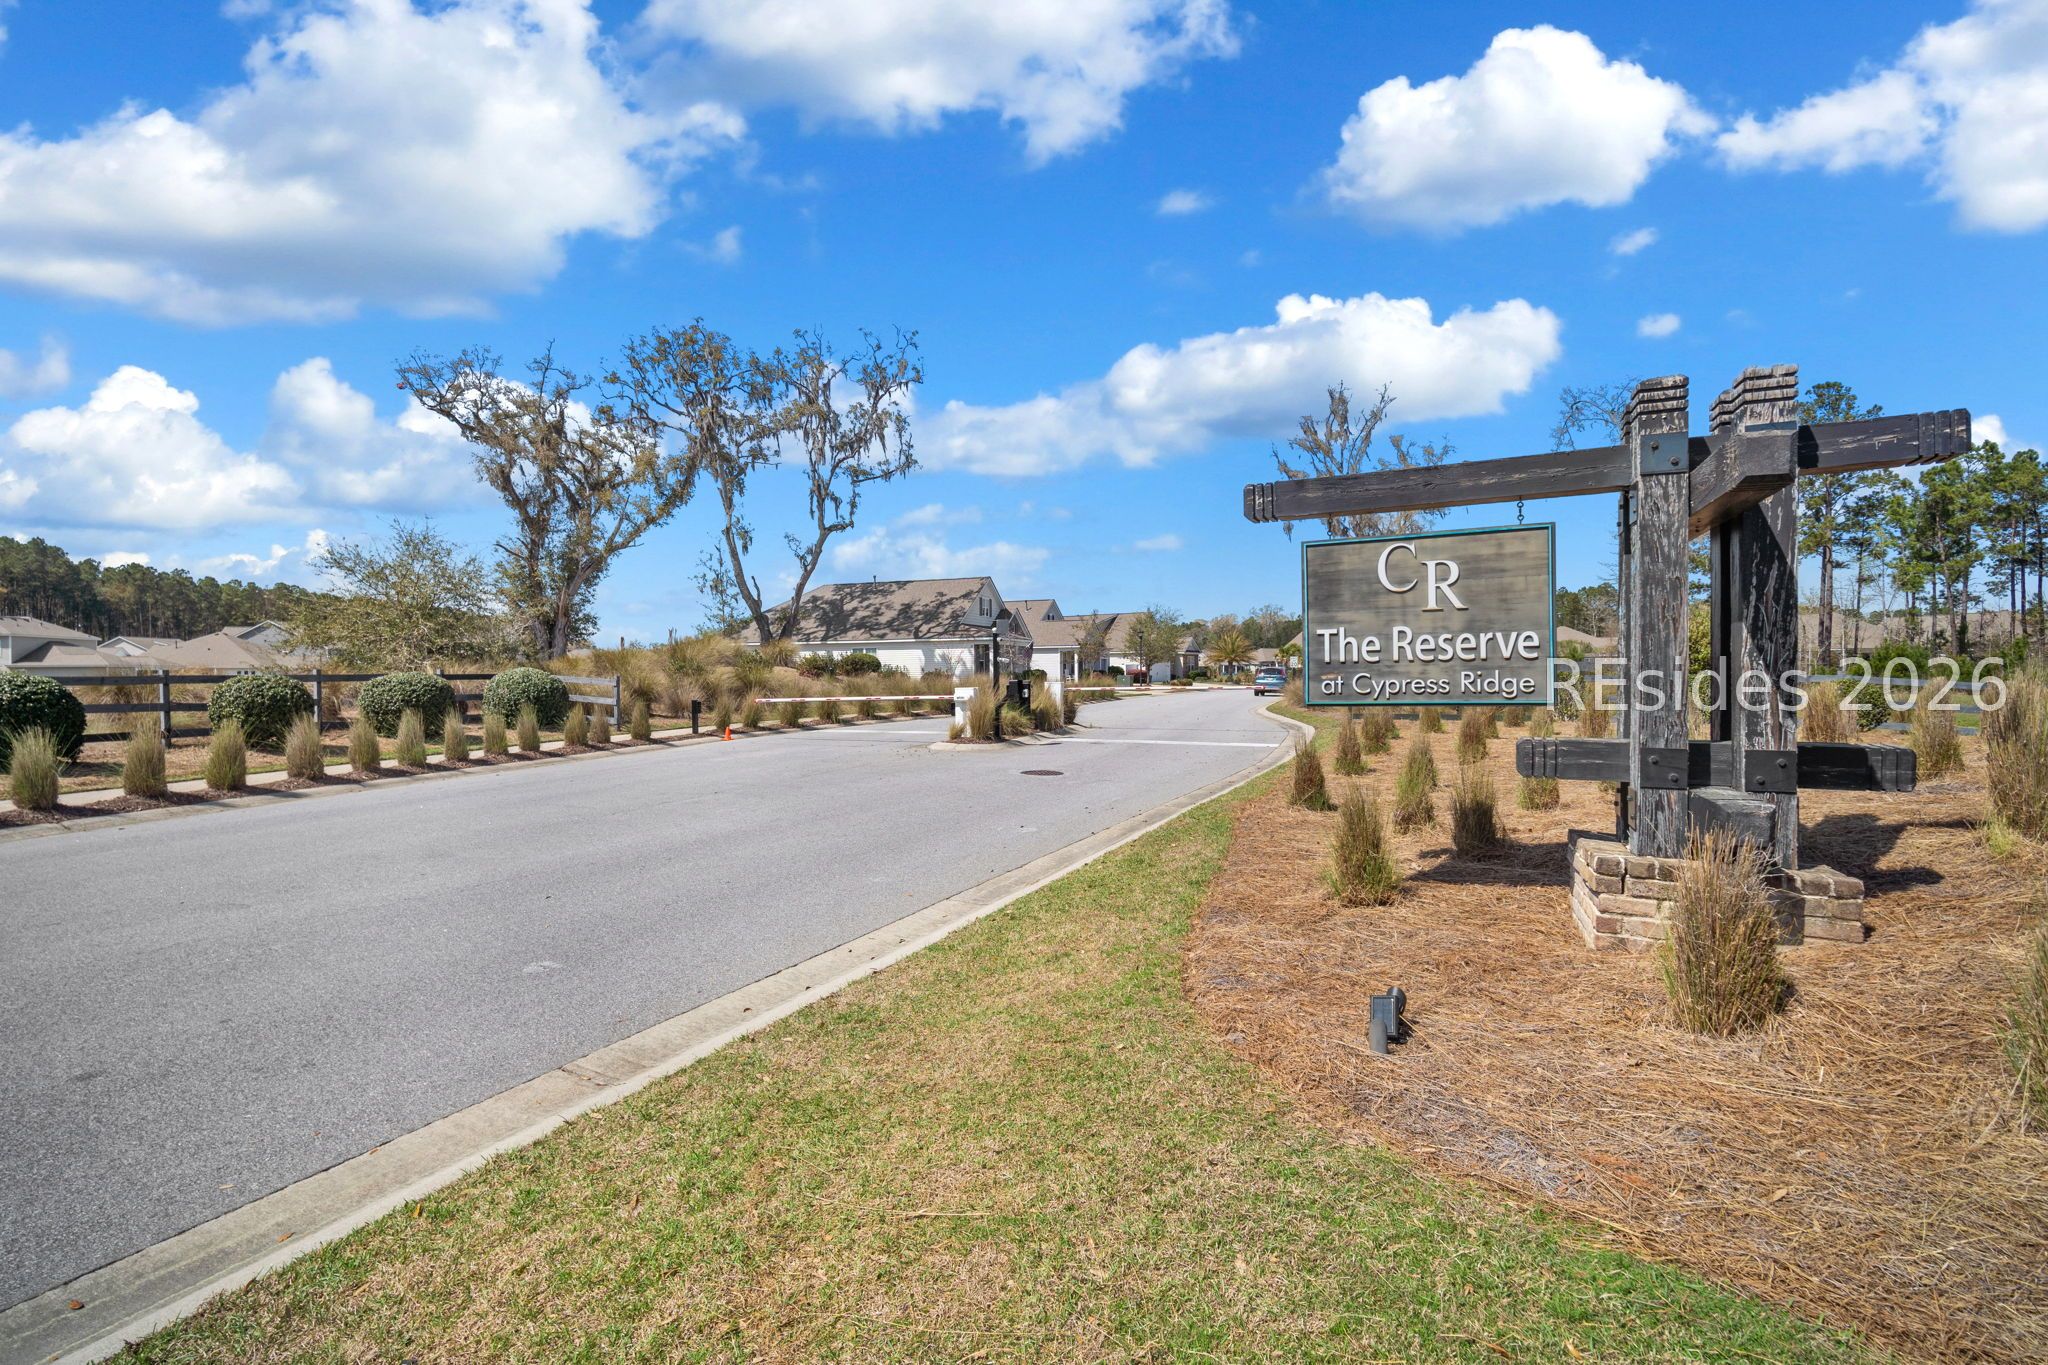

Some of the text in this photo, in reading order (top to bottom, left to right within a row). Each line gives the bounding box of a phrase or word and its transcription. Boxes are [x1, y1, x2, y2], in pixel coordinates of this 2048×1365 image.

[1316, 625, 1540, 663] The Reserve
[1321, 670, 1535, 699] at Cypress Ridge
